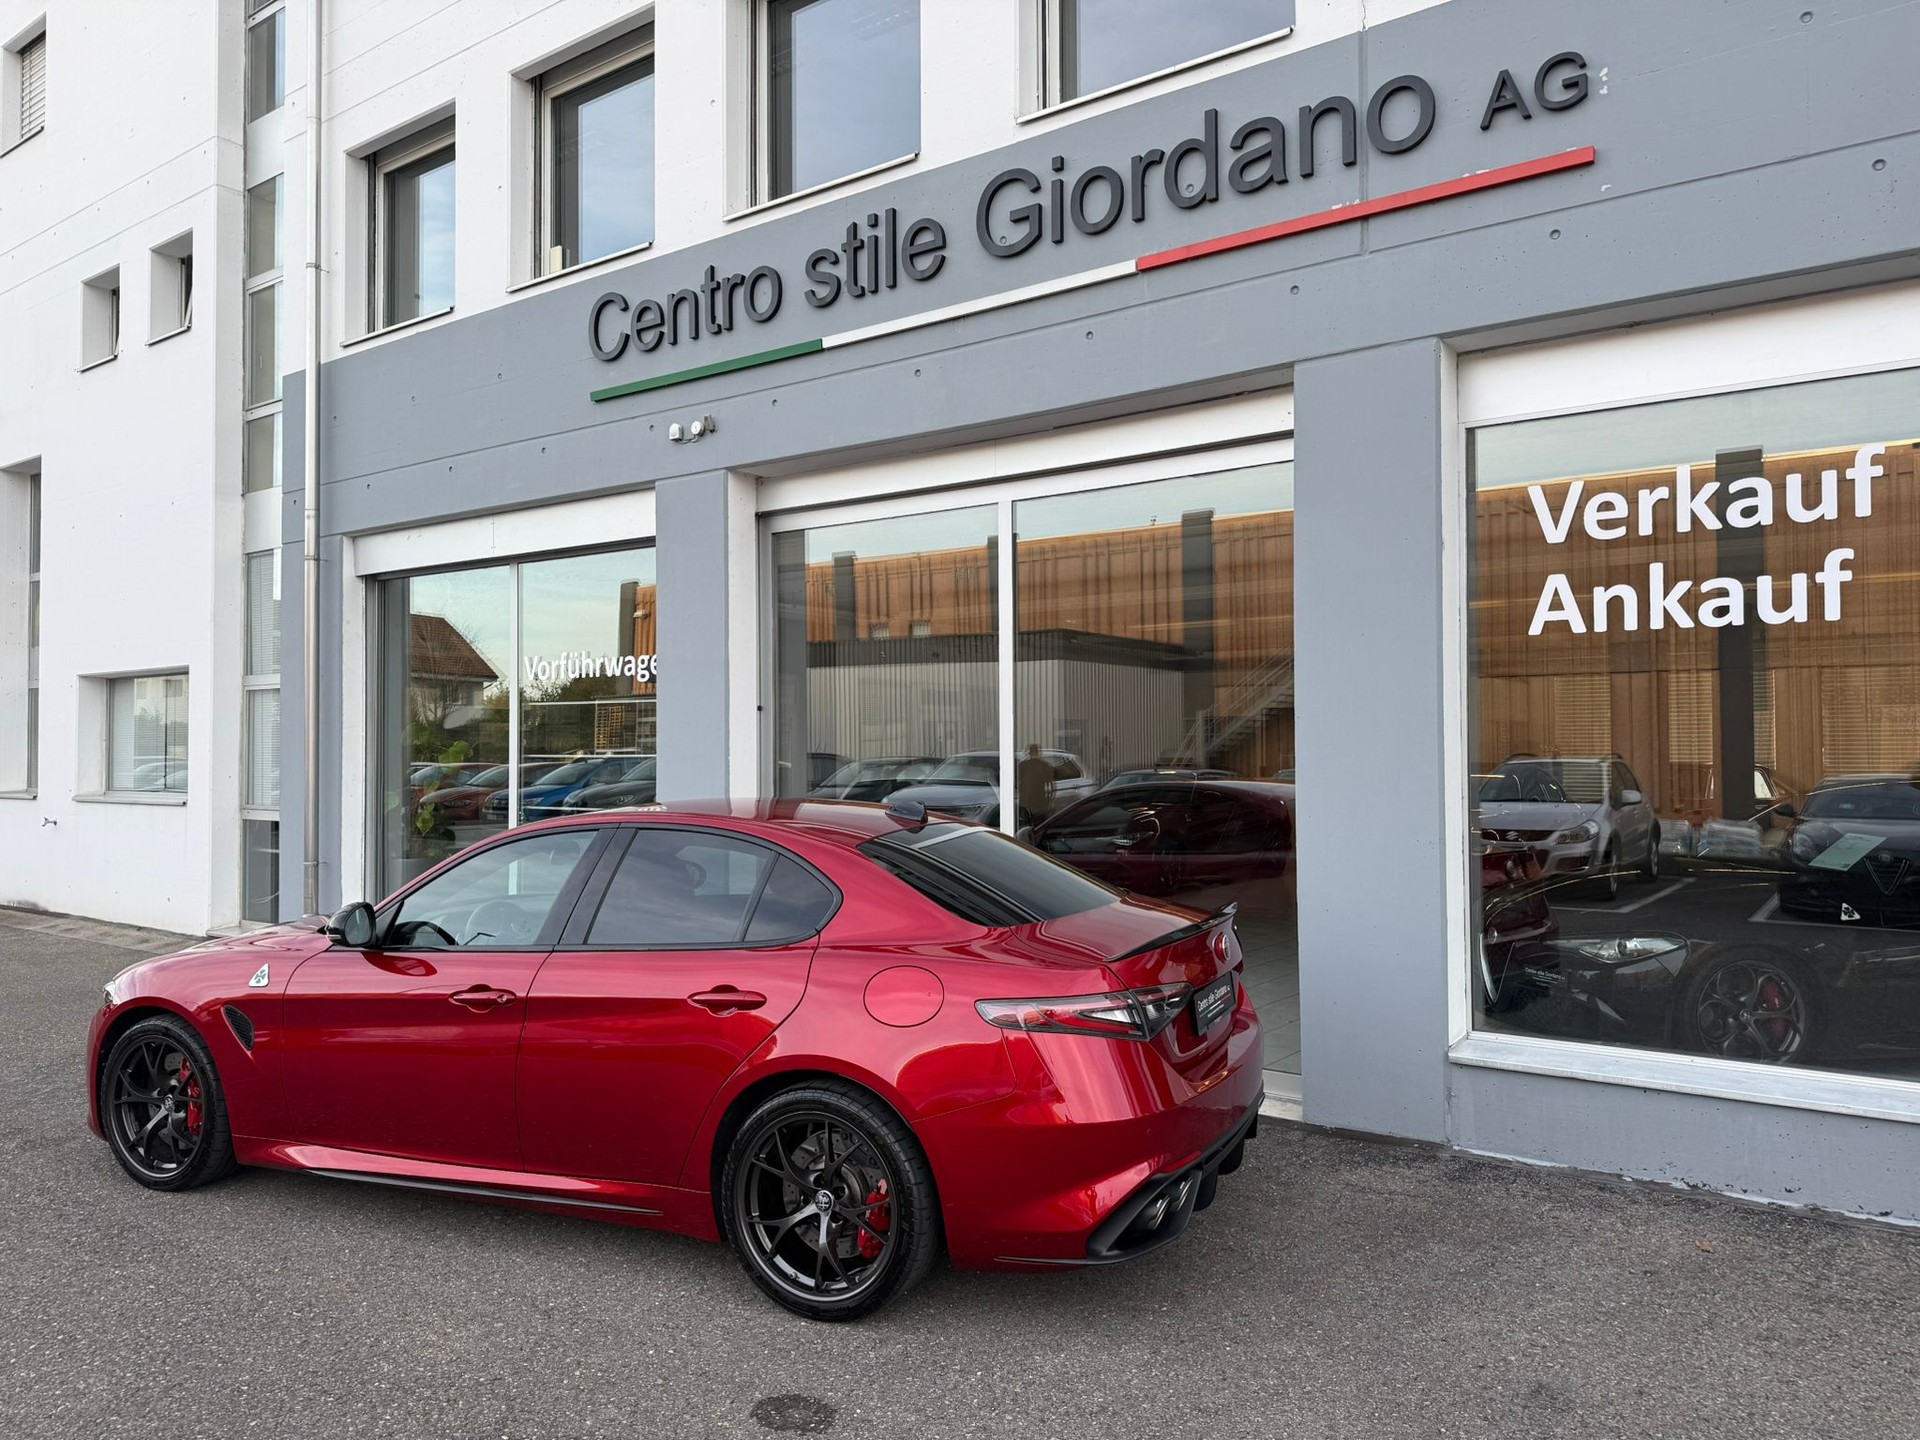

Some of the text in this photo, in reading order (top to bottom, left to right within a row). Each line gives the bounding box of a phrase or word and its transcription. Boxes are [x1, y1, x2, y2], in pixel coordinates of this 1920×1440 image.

[588, 50, 1590, 362] Centro stile Giordano AG
[1527, 443, 1886, 544] Verkauf
[1527, 547, 1855, 636] Ankauf
